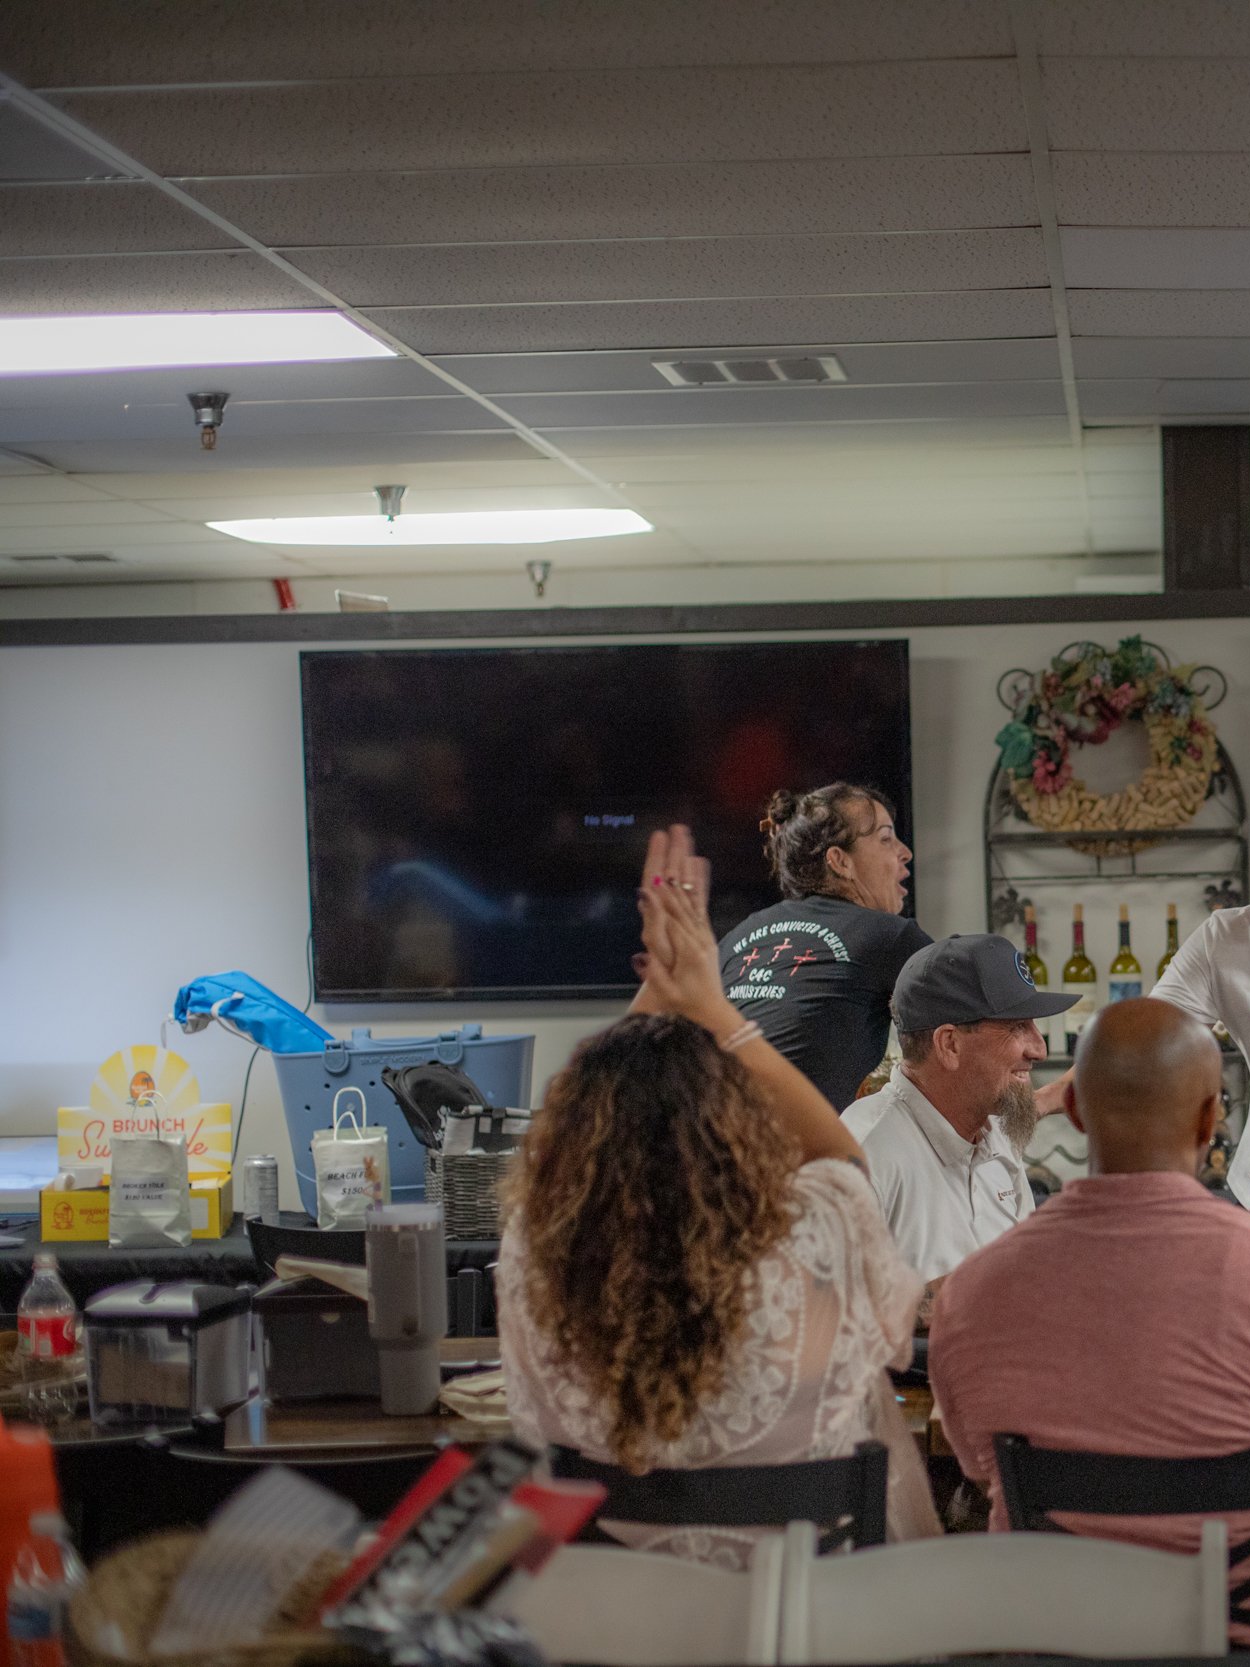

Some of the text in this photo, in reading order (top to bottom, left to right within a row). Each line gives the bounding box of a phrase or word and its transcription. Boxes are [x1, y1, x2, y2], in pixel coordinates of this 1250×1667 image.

[733, 920, 850, 962] WE ARE CONVICTED 4 CHRIST
[749, 968, 773, 982] C4C
[112, 1118, 185, 1133] BRUNCH
[327, 1171, 356, 1181] BEACH
